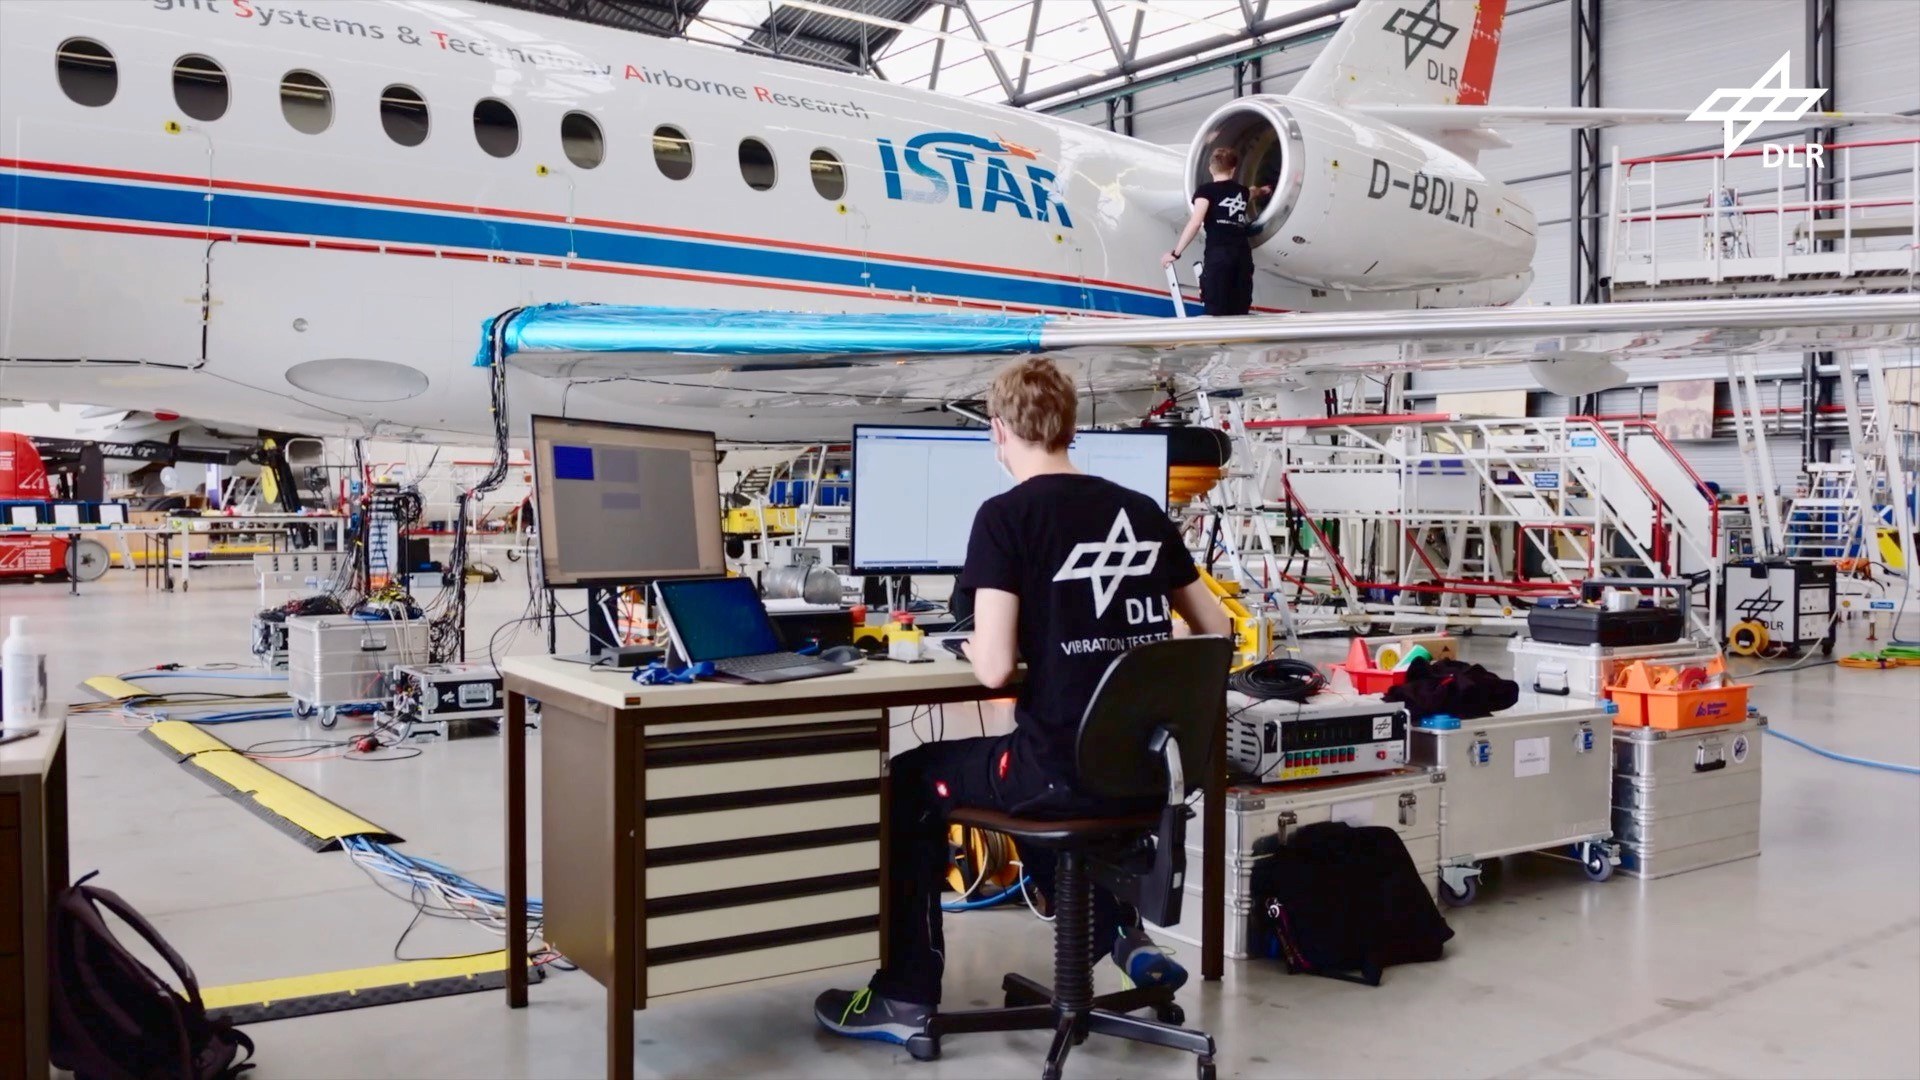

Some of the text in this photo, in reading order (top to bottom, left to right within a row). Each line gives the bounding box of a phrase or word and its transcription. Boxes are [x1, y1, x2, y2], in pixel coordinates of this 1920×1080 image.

[233, 0, 384, 40] Systems
[397, 26, 422, 47] &
[624, 64, 748, 100] Airborne
[753, 86, 870, 120] Research
[1427, 58, 1460, 90] DLR
[876, 131, 1074, 229] ISTAR
[1367, 158, 1479, 229] D-BDLR
[1060, 637, 1126, 656] VIBRATION
